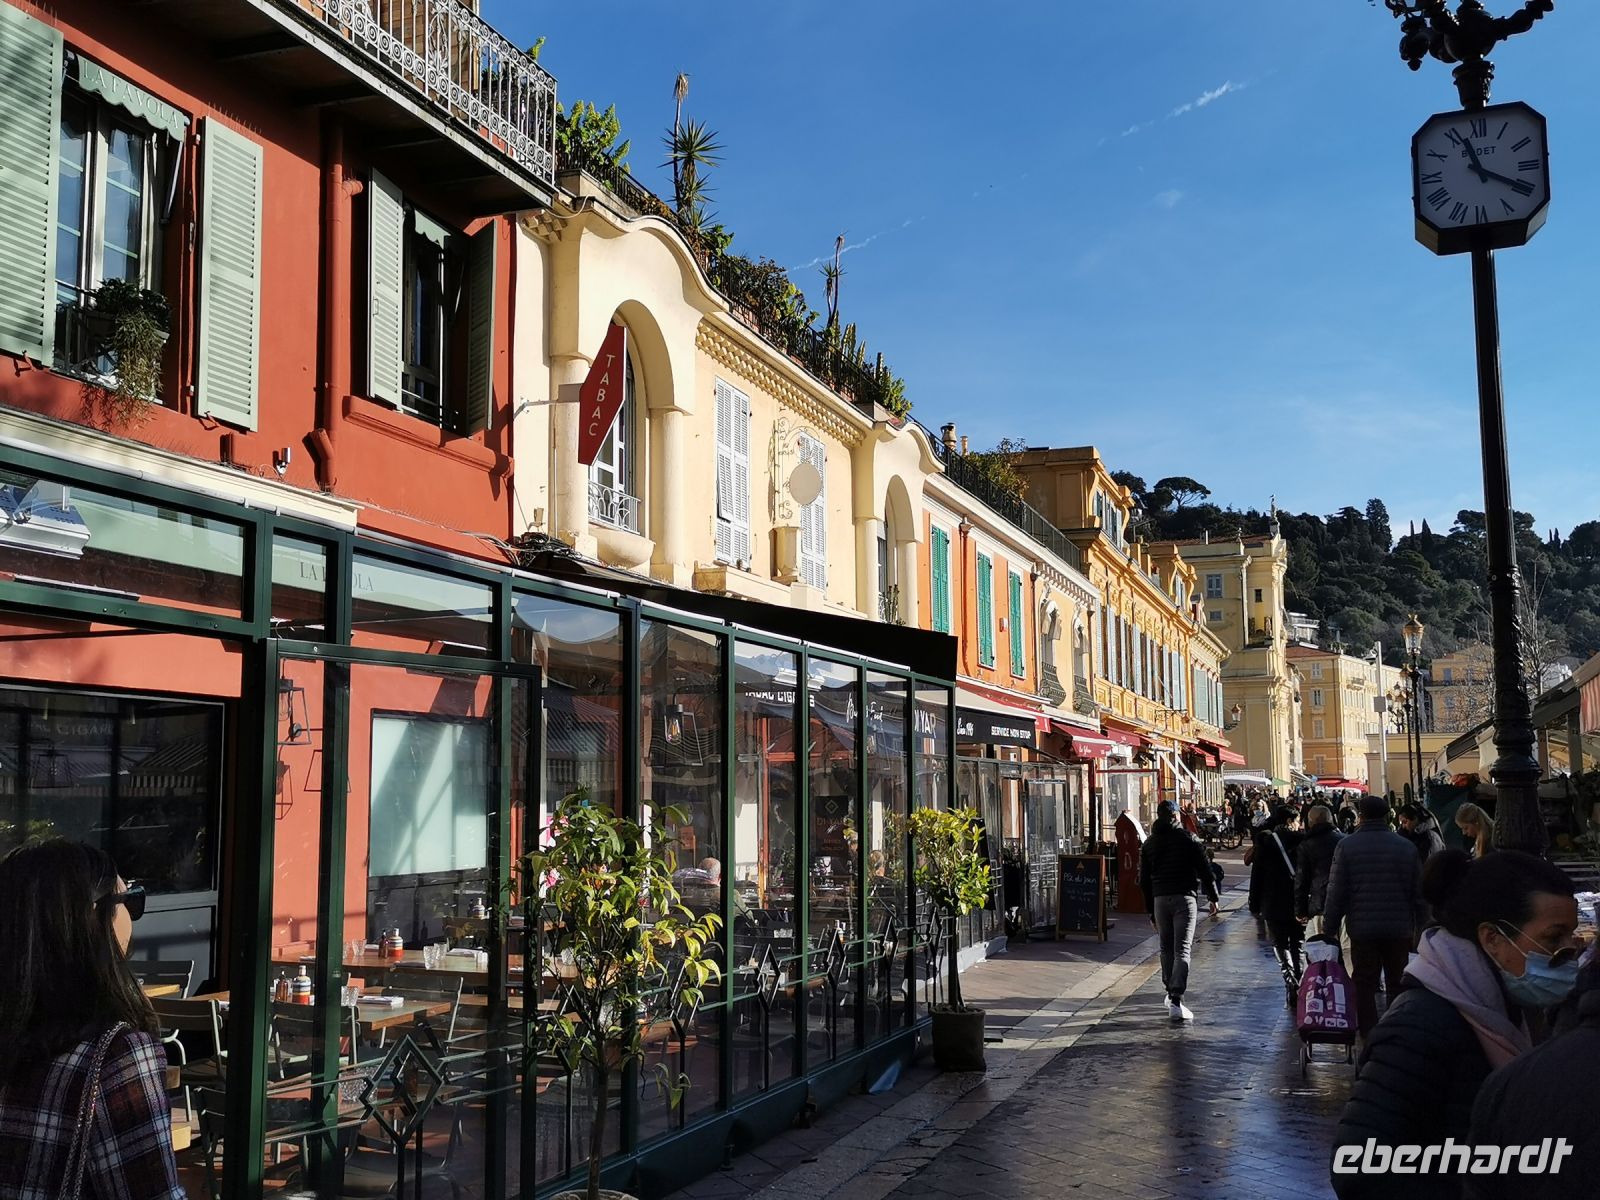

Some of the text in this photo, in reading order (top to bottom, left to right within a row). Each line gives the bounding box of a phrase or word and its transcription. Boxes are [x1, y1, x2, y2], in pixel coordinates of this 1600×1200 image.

[83, 60, 179, 129] LA FAVOLA
[1470, 118, 1487, 139] XII
[1461, 145, 1497, 159] BDET
[1518, 159, 1540, 172] III
[588, 354, 616, 437] TABAC
[299, 561, 318, 581] LA
[991, 725, 1031, 739] SERVICE NON STOP
